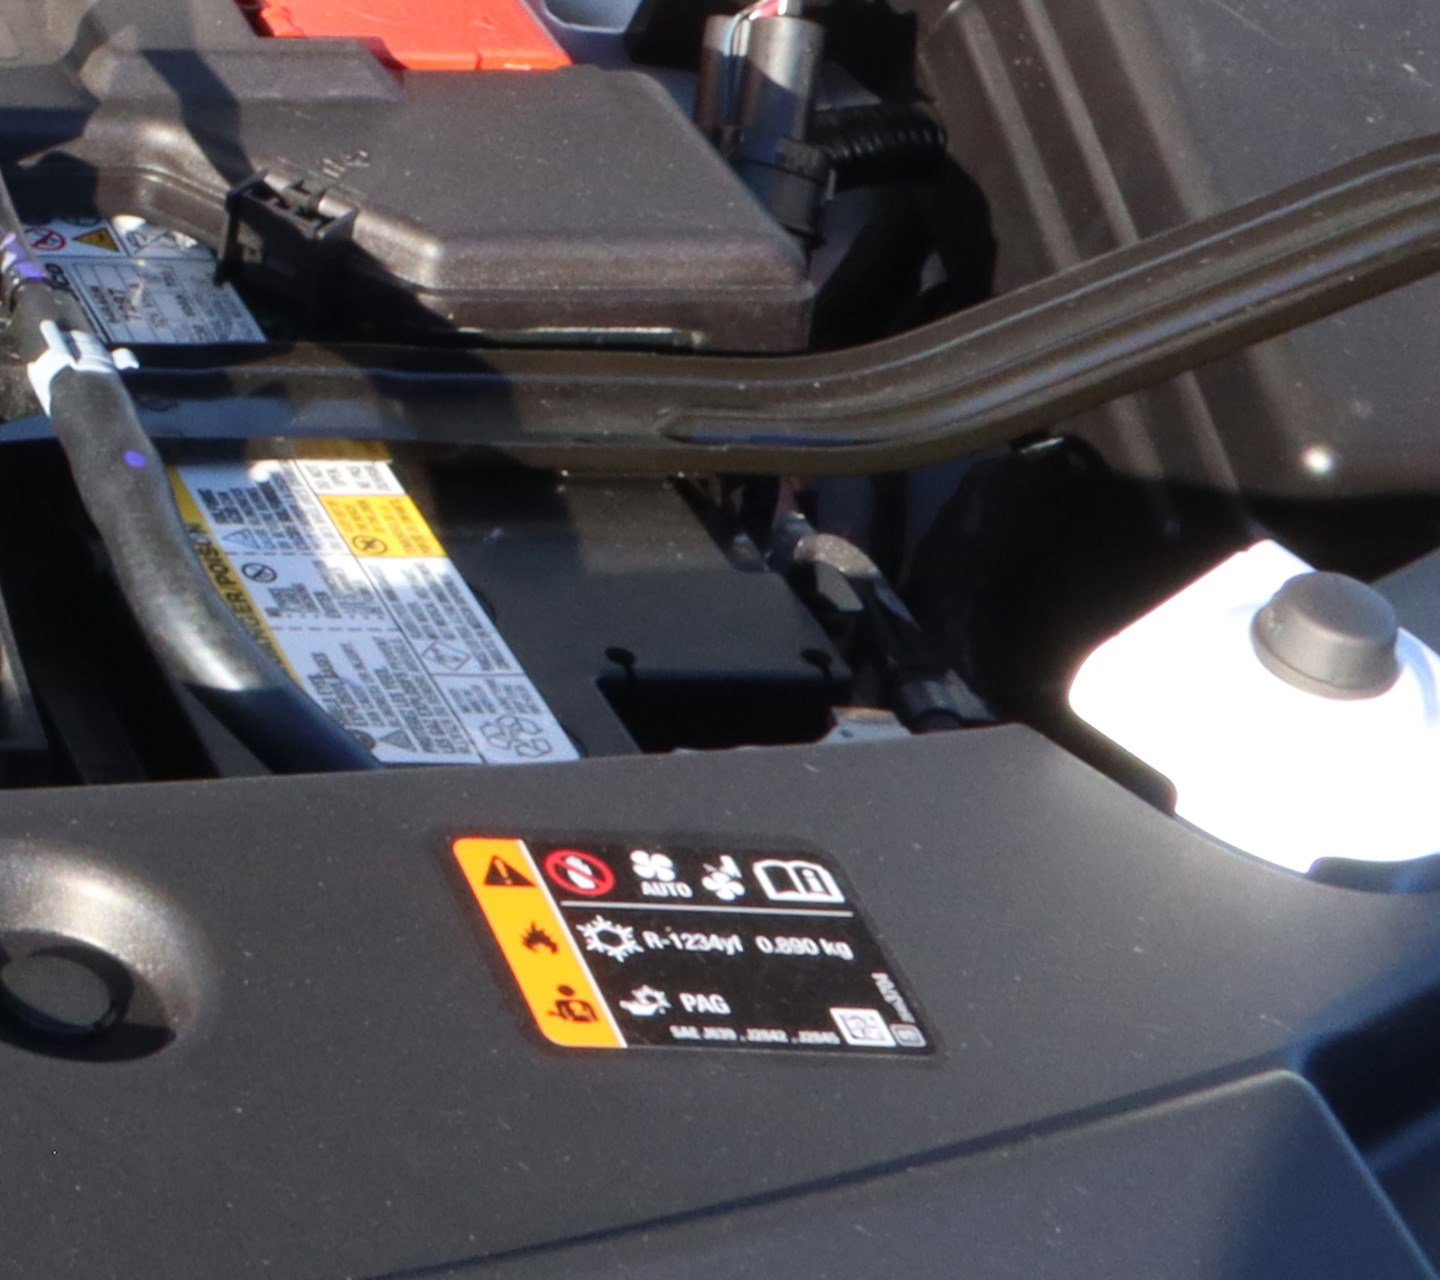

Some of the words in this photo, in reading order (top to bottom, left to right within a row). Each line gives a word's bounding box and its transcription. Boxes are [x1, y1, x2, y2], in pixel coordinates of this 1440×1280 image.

[640, 881, 694, 899] AUTO
[641, 930, 745, 956] R-1234yf
[818, 937, 855, 961] kg
[679, 992, 732, 1015] PAG
